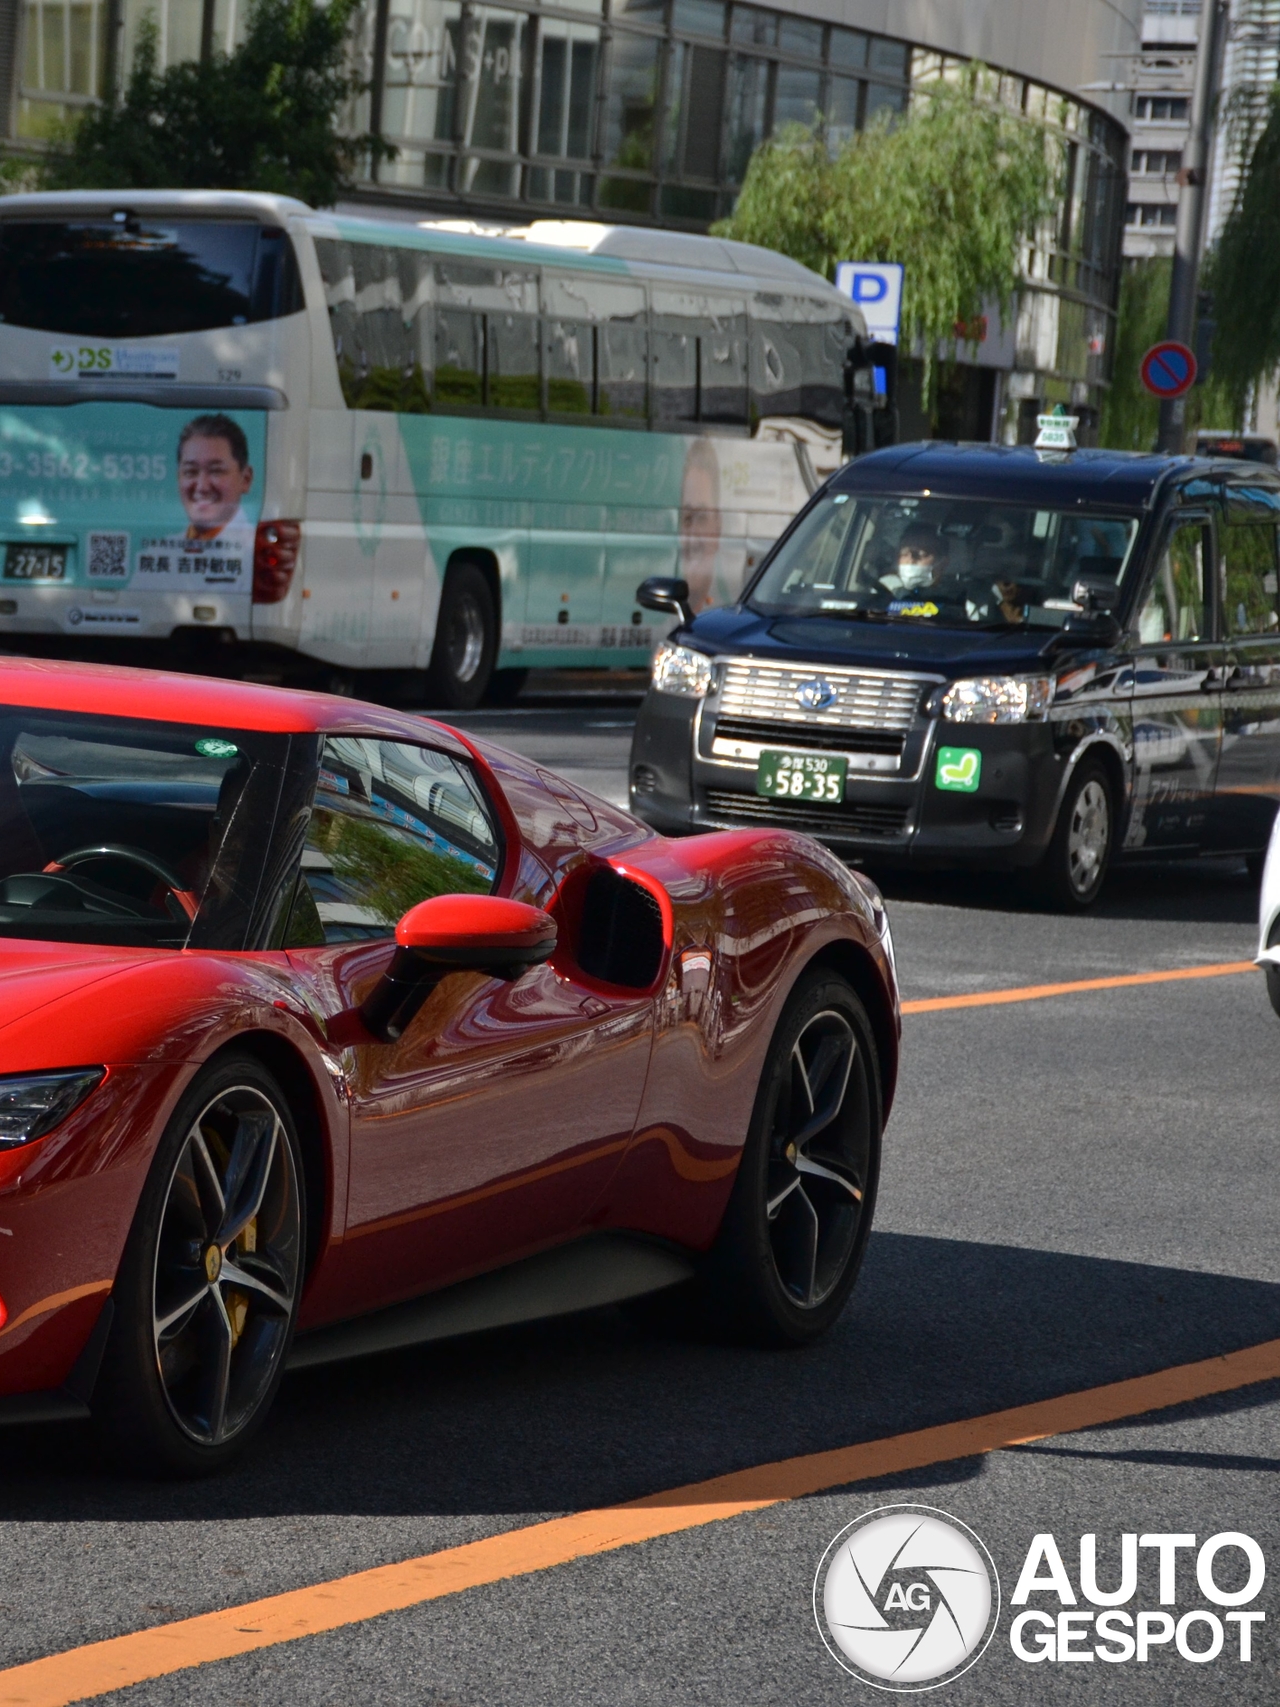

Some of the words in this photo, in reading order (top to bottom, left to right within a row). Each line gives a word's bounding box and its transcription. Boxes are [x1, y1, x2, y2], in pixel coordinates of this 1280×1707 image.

[852, 273, 888, 304] P
[140, 555, 170, 573] 院長
[775, 769, 841, 800] 58-35
